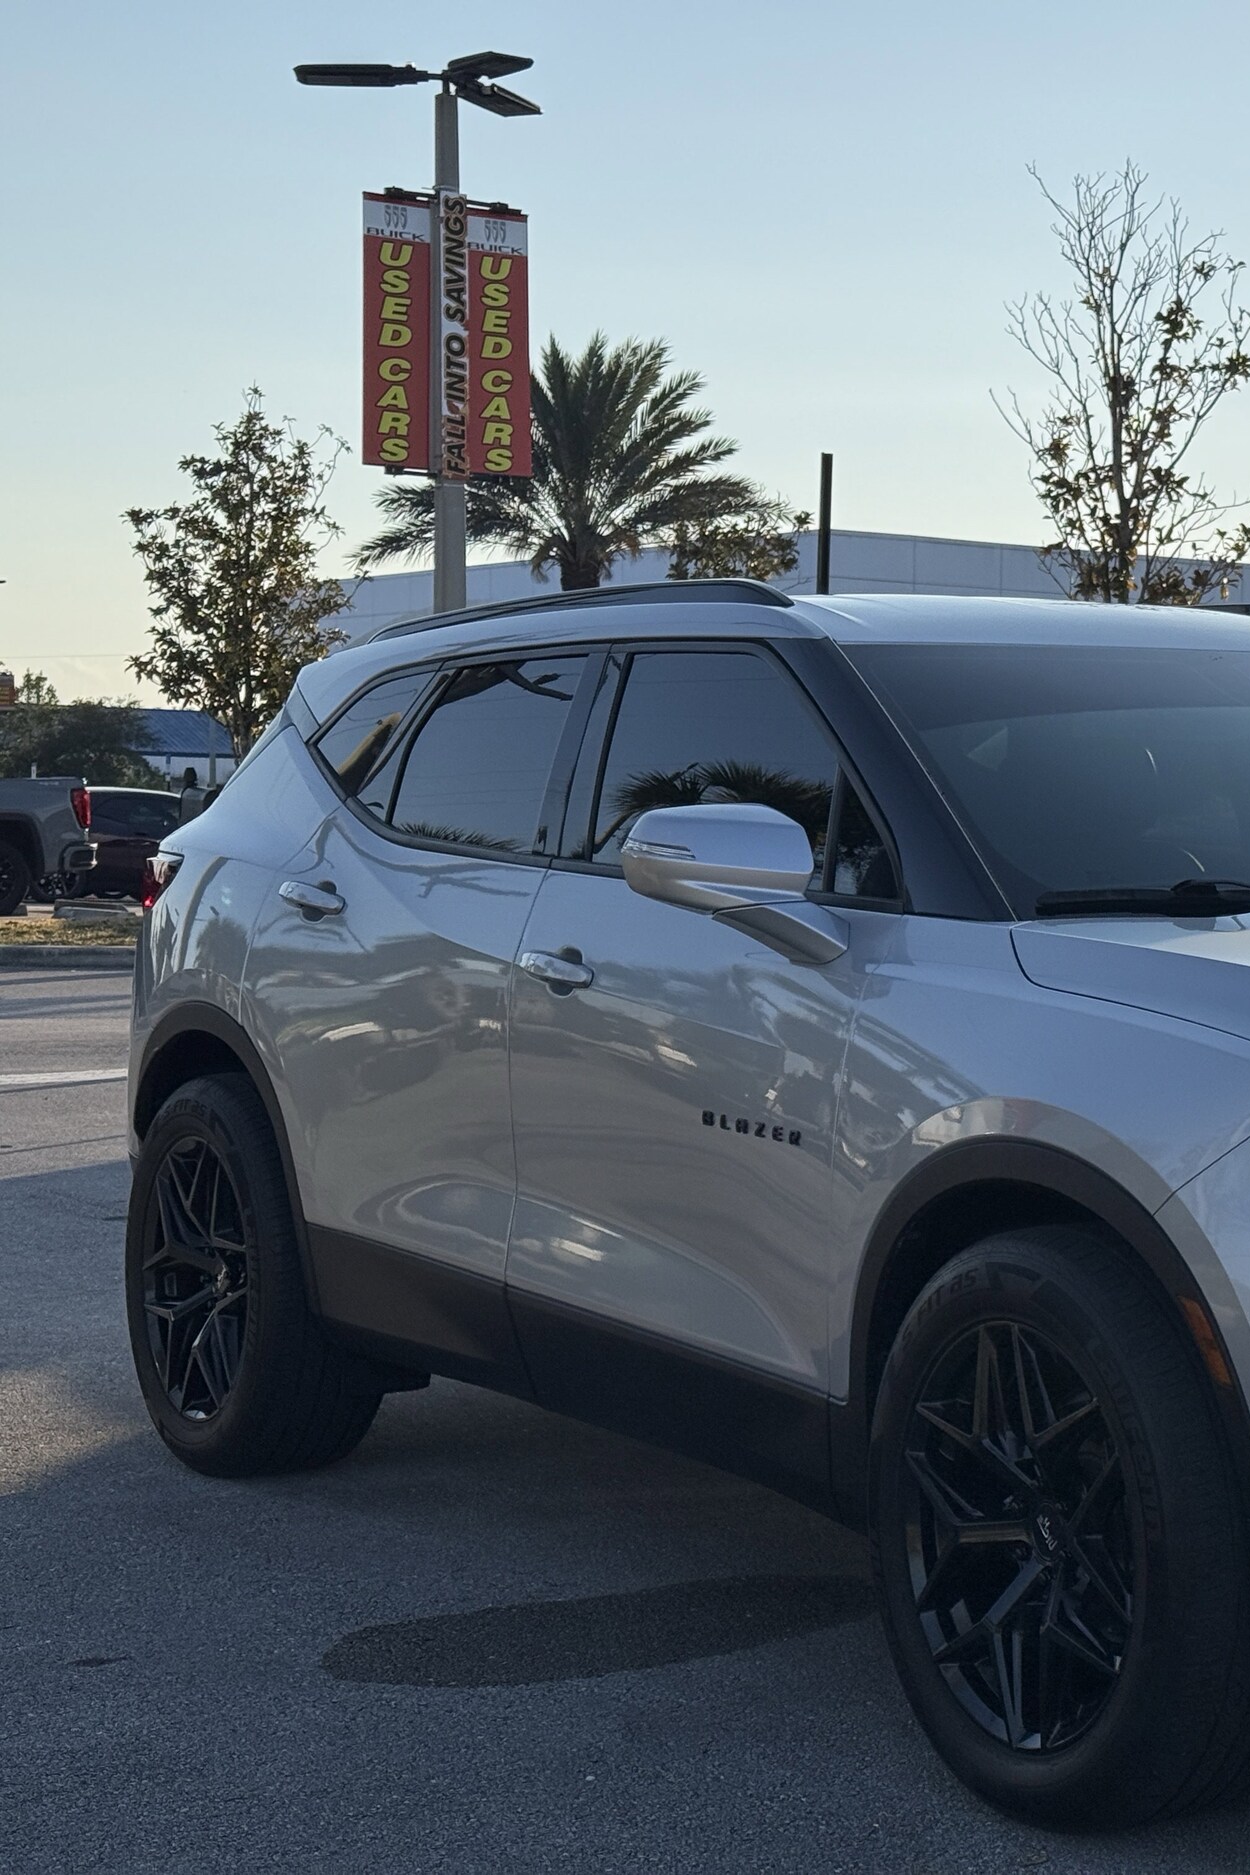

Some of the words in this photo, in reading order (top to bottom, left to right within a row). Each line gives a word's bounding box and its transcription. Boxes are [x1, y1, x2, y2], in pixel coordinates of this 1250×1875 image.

[366, 227, 424, 241] BUICK
[442, 195, 467, 323] SAVINGS
[378, 242, 413, 347] USED
[479, 255, 513, 360] USED
[375, 357, 412, 462] CARS
[443, 333, 467, 402] INTO
[479, 369, 514, 473] CARS
[702, 1110, 801, 1146] BLAZER
